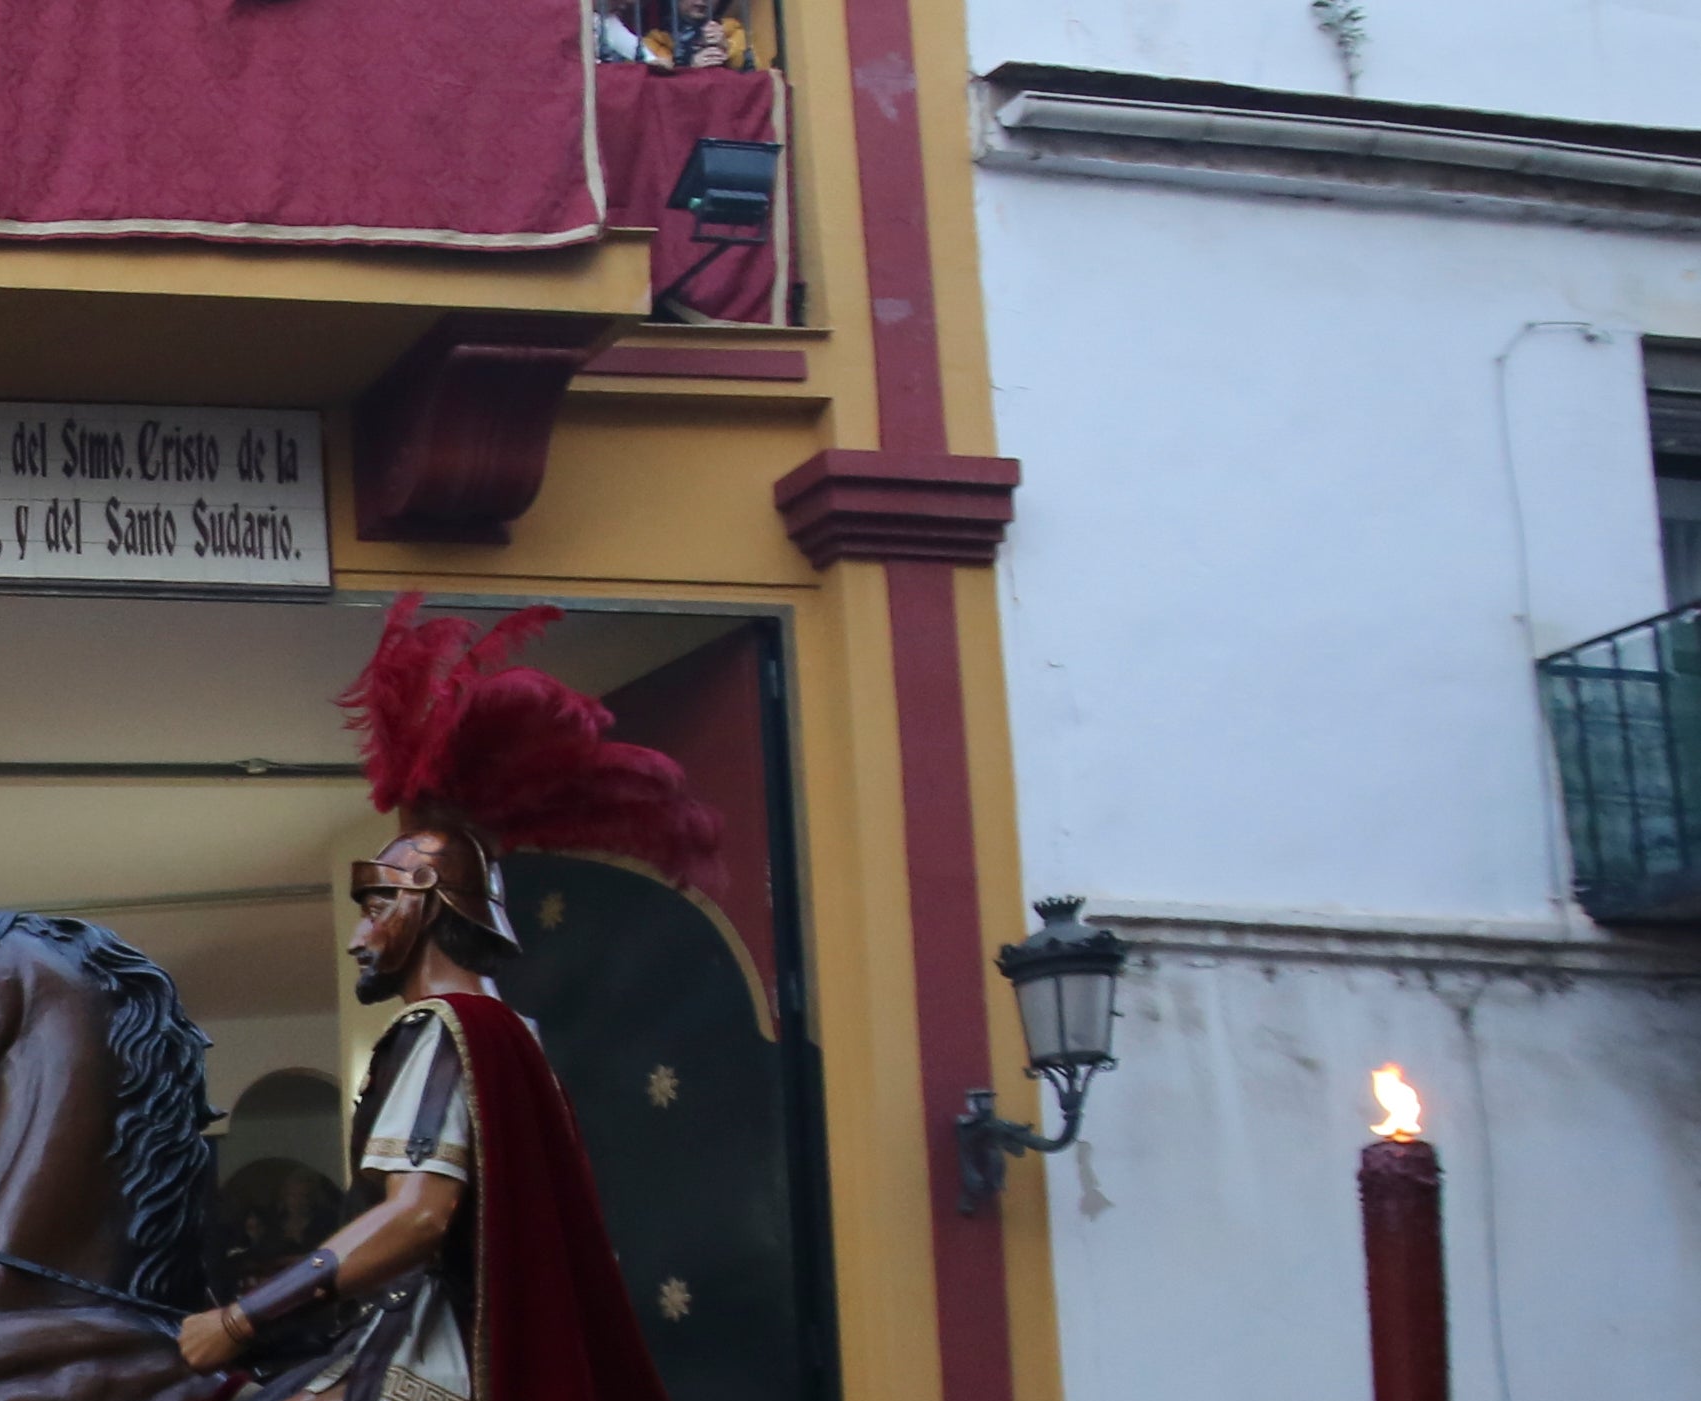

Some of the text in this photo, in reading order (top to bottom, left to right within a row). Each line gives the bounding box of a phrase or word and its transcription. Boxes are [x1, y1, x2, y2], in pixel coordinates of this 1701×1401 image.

[12, 422, 46, 477] del
[62, 419, 132, 478] Stmo.
[138, 421, 219, 481] Cristo
[237, 428, 266, 482] de
[277, 430, 298, 483] la
[16, 506, 29, 559] y
[45, 499, 82, 554] del
[106, 496, 176, 556] Santo
[193, 498, 301, 560] Sudario.
